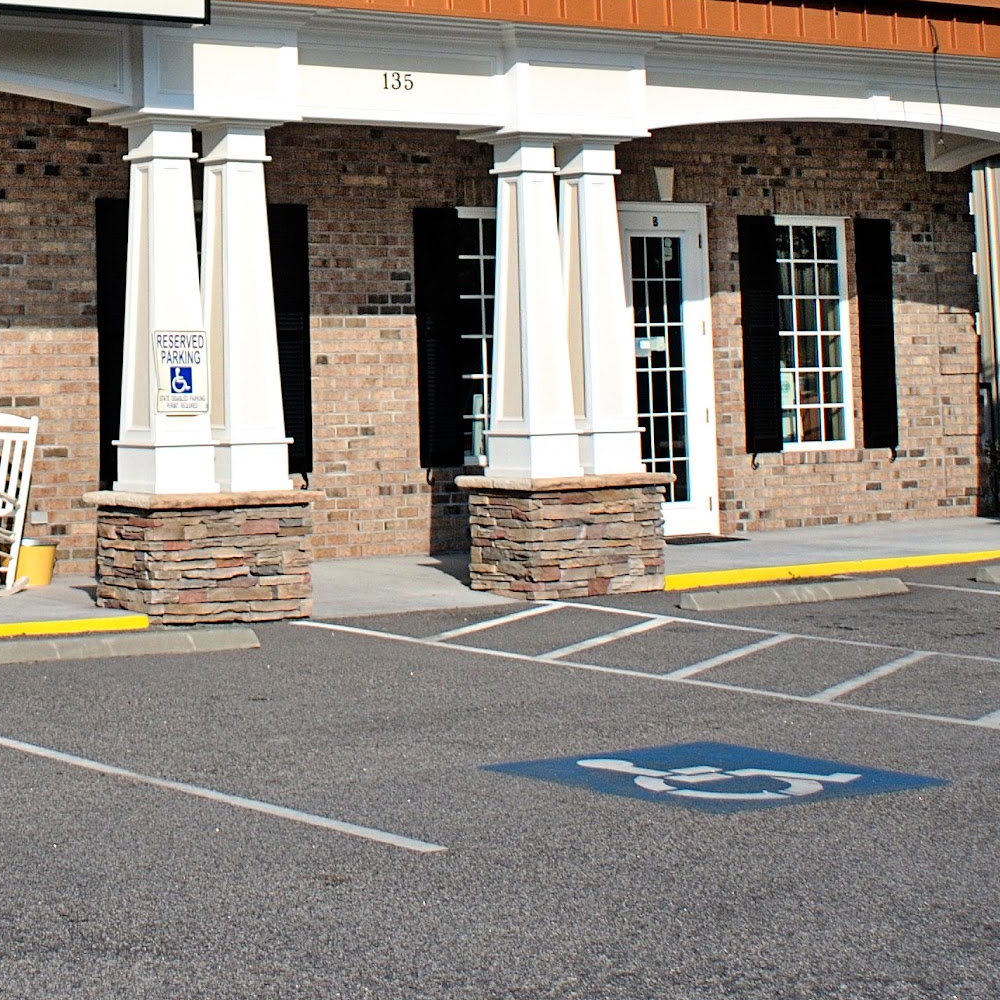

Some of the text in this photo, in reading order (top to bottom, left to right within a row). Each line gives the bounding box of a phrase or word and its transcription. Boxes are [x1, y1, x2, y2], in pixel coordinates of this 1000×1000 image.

[383, 71, 414, 90] 135
[157, 334, 204, 349] RESERVED
[161, 350, 201, 365] PARKING
